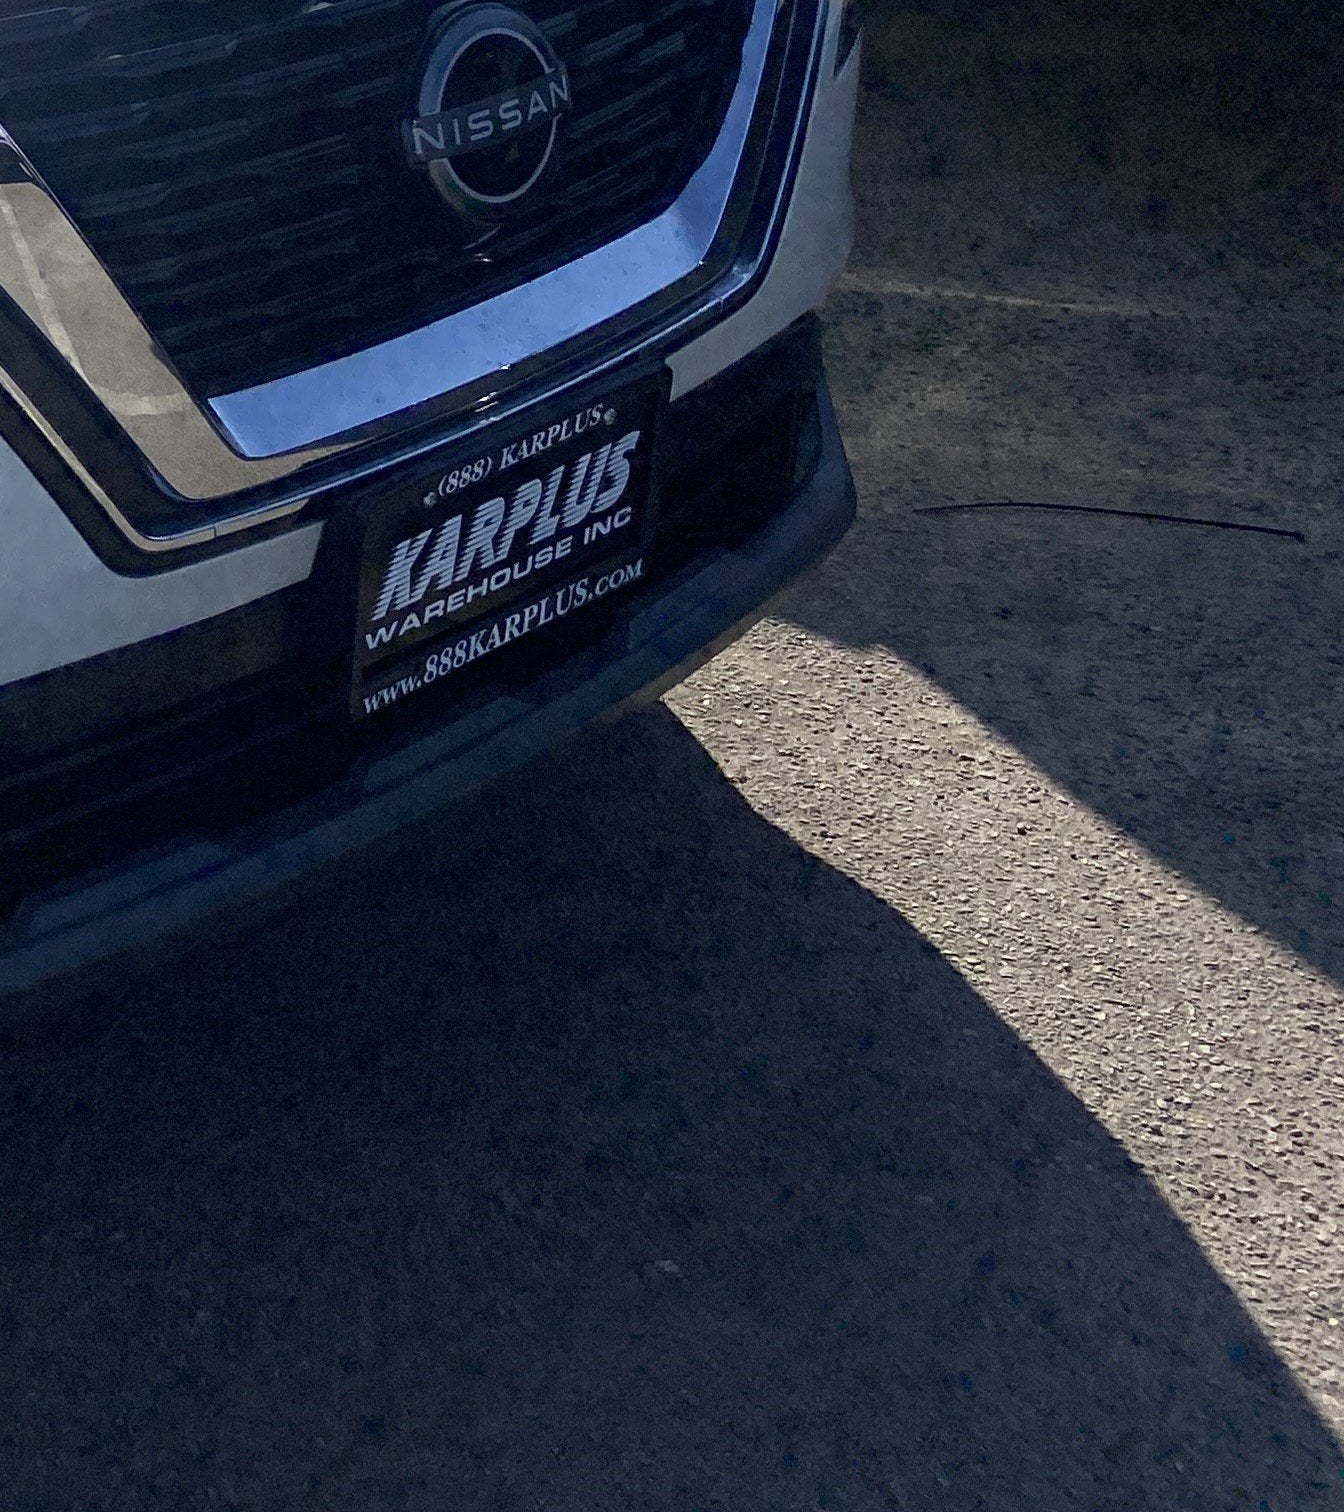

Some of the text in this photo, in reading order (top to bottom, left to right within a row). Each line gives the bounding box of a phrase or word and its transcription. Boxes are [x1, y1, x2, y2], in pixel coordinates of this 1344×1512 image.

[413, 74, 568, 155] NISSAN
[438, 402, 604, 497] (888) KARPLUS
[365, 506, 633, 650] WAREHOUSE INC
[372, 430, 641, 621] KARPLUS
